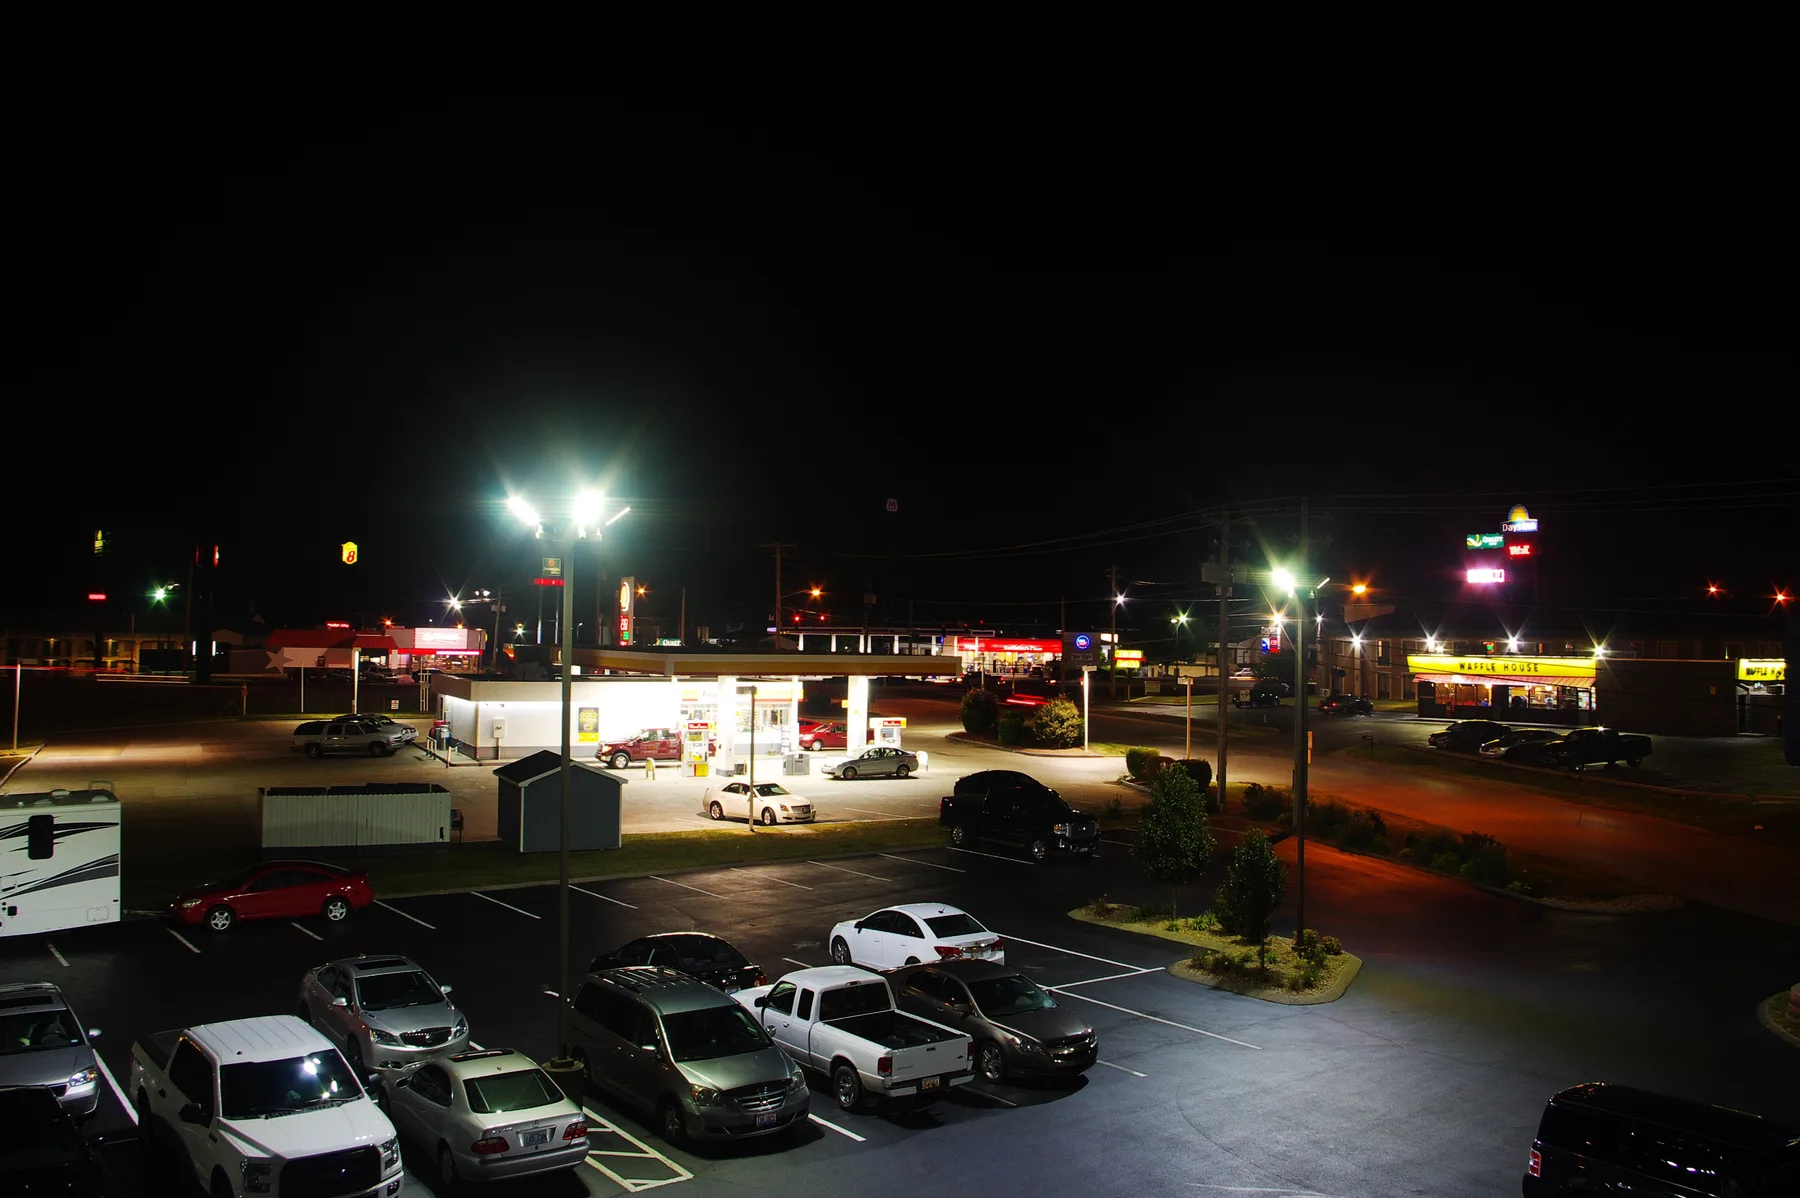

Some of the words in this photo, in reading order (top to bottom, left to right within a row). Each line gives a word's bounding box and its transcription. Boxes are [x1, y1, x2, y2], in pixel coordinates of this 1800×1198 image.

[1502, 523, 1521, 532] Days
[347, 551, 355, 562] 8
[1459, 662, 1496, 672] WAFFLE
[1504, 663, 1539, 672] HOUSE
